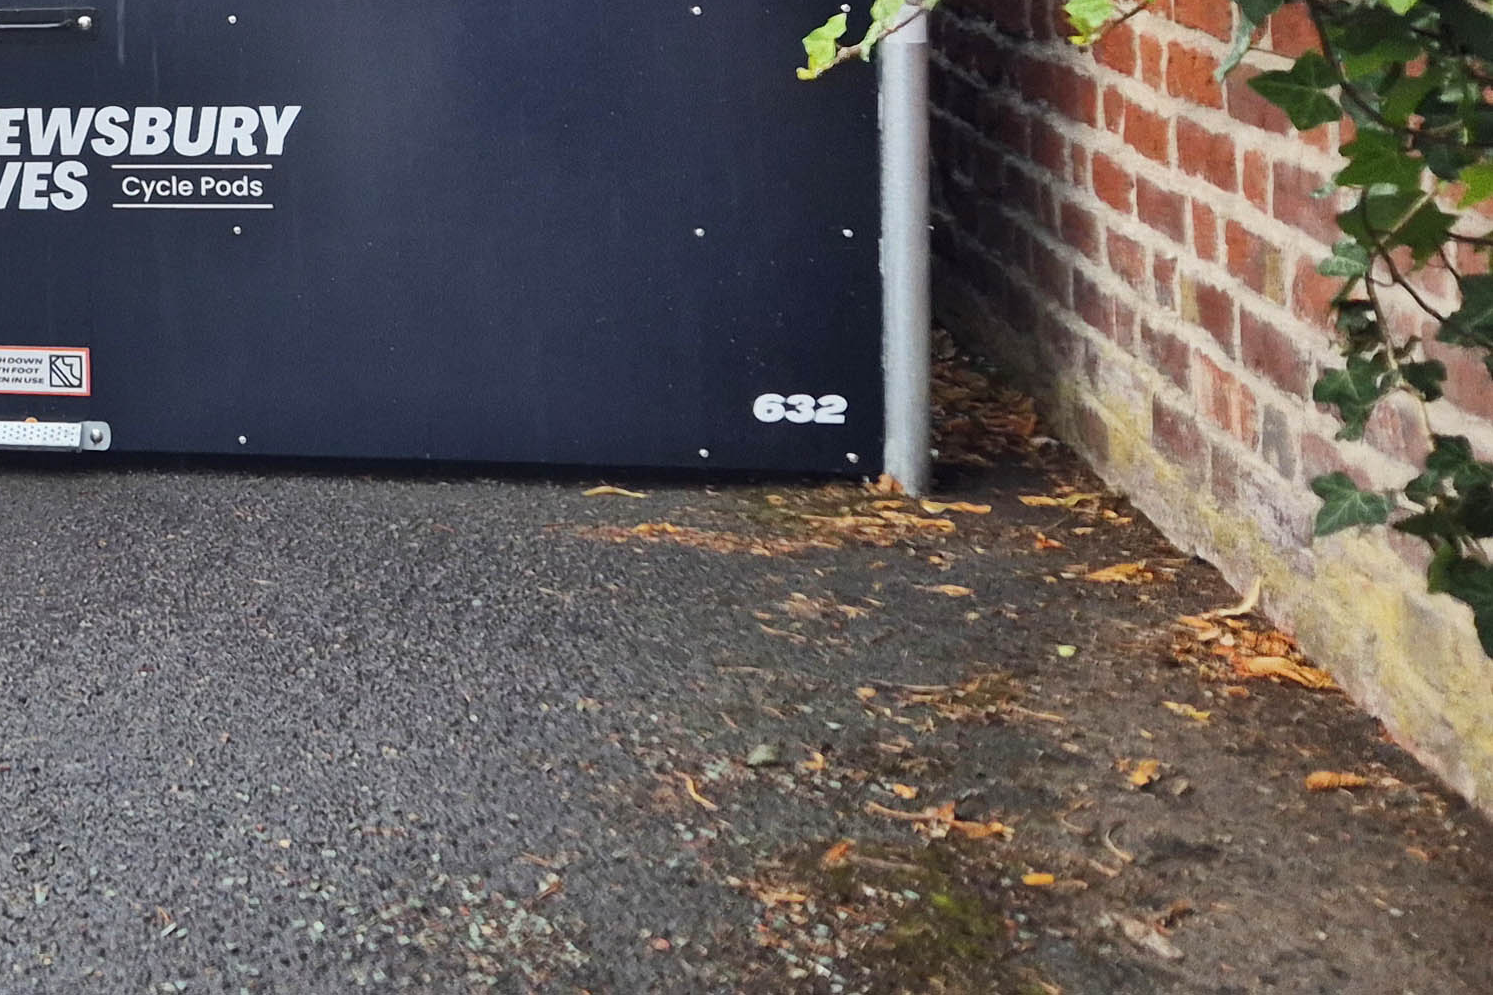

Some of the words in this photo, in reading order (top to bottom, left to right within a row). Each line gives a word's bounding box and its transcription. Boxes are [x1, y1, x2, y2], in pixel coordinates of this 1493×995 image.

[121, 175, 193, 202] Cycle
[200, 175, 263, 197] Pods
[7, 357, 43, 365] DOWN
[10, 367, 40, 375] FOOT
[11, 376, 23, 384] IN
[24, 377, 44, 385] USE
[752, 393, 848, 424] 632
